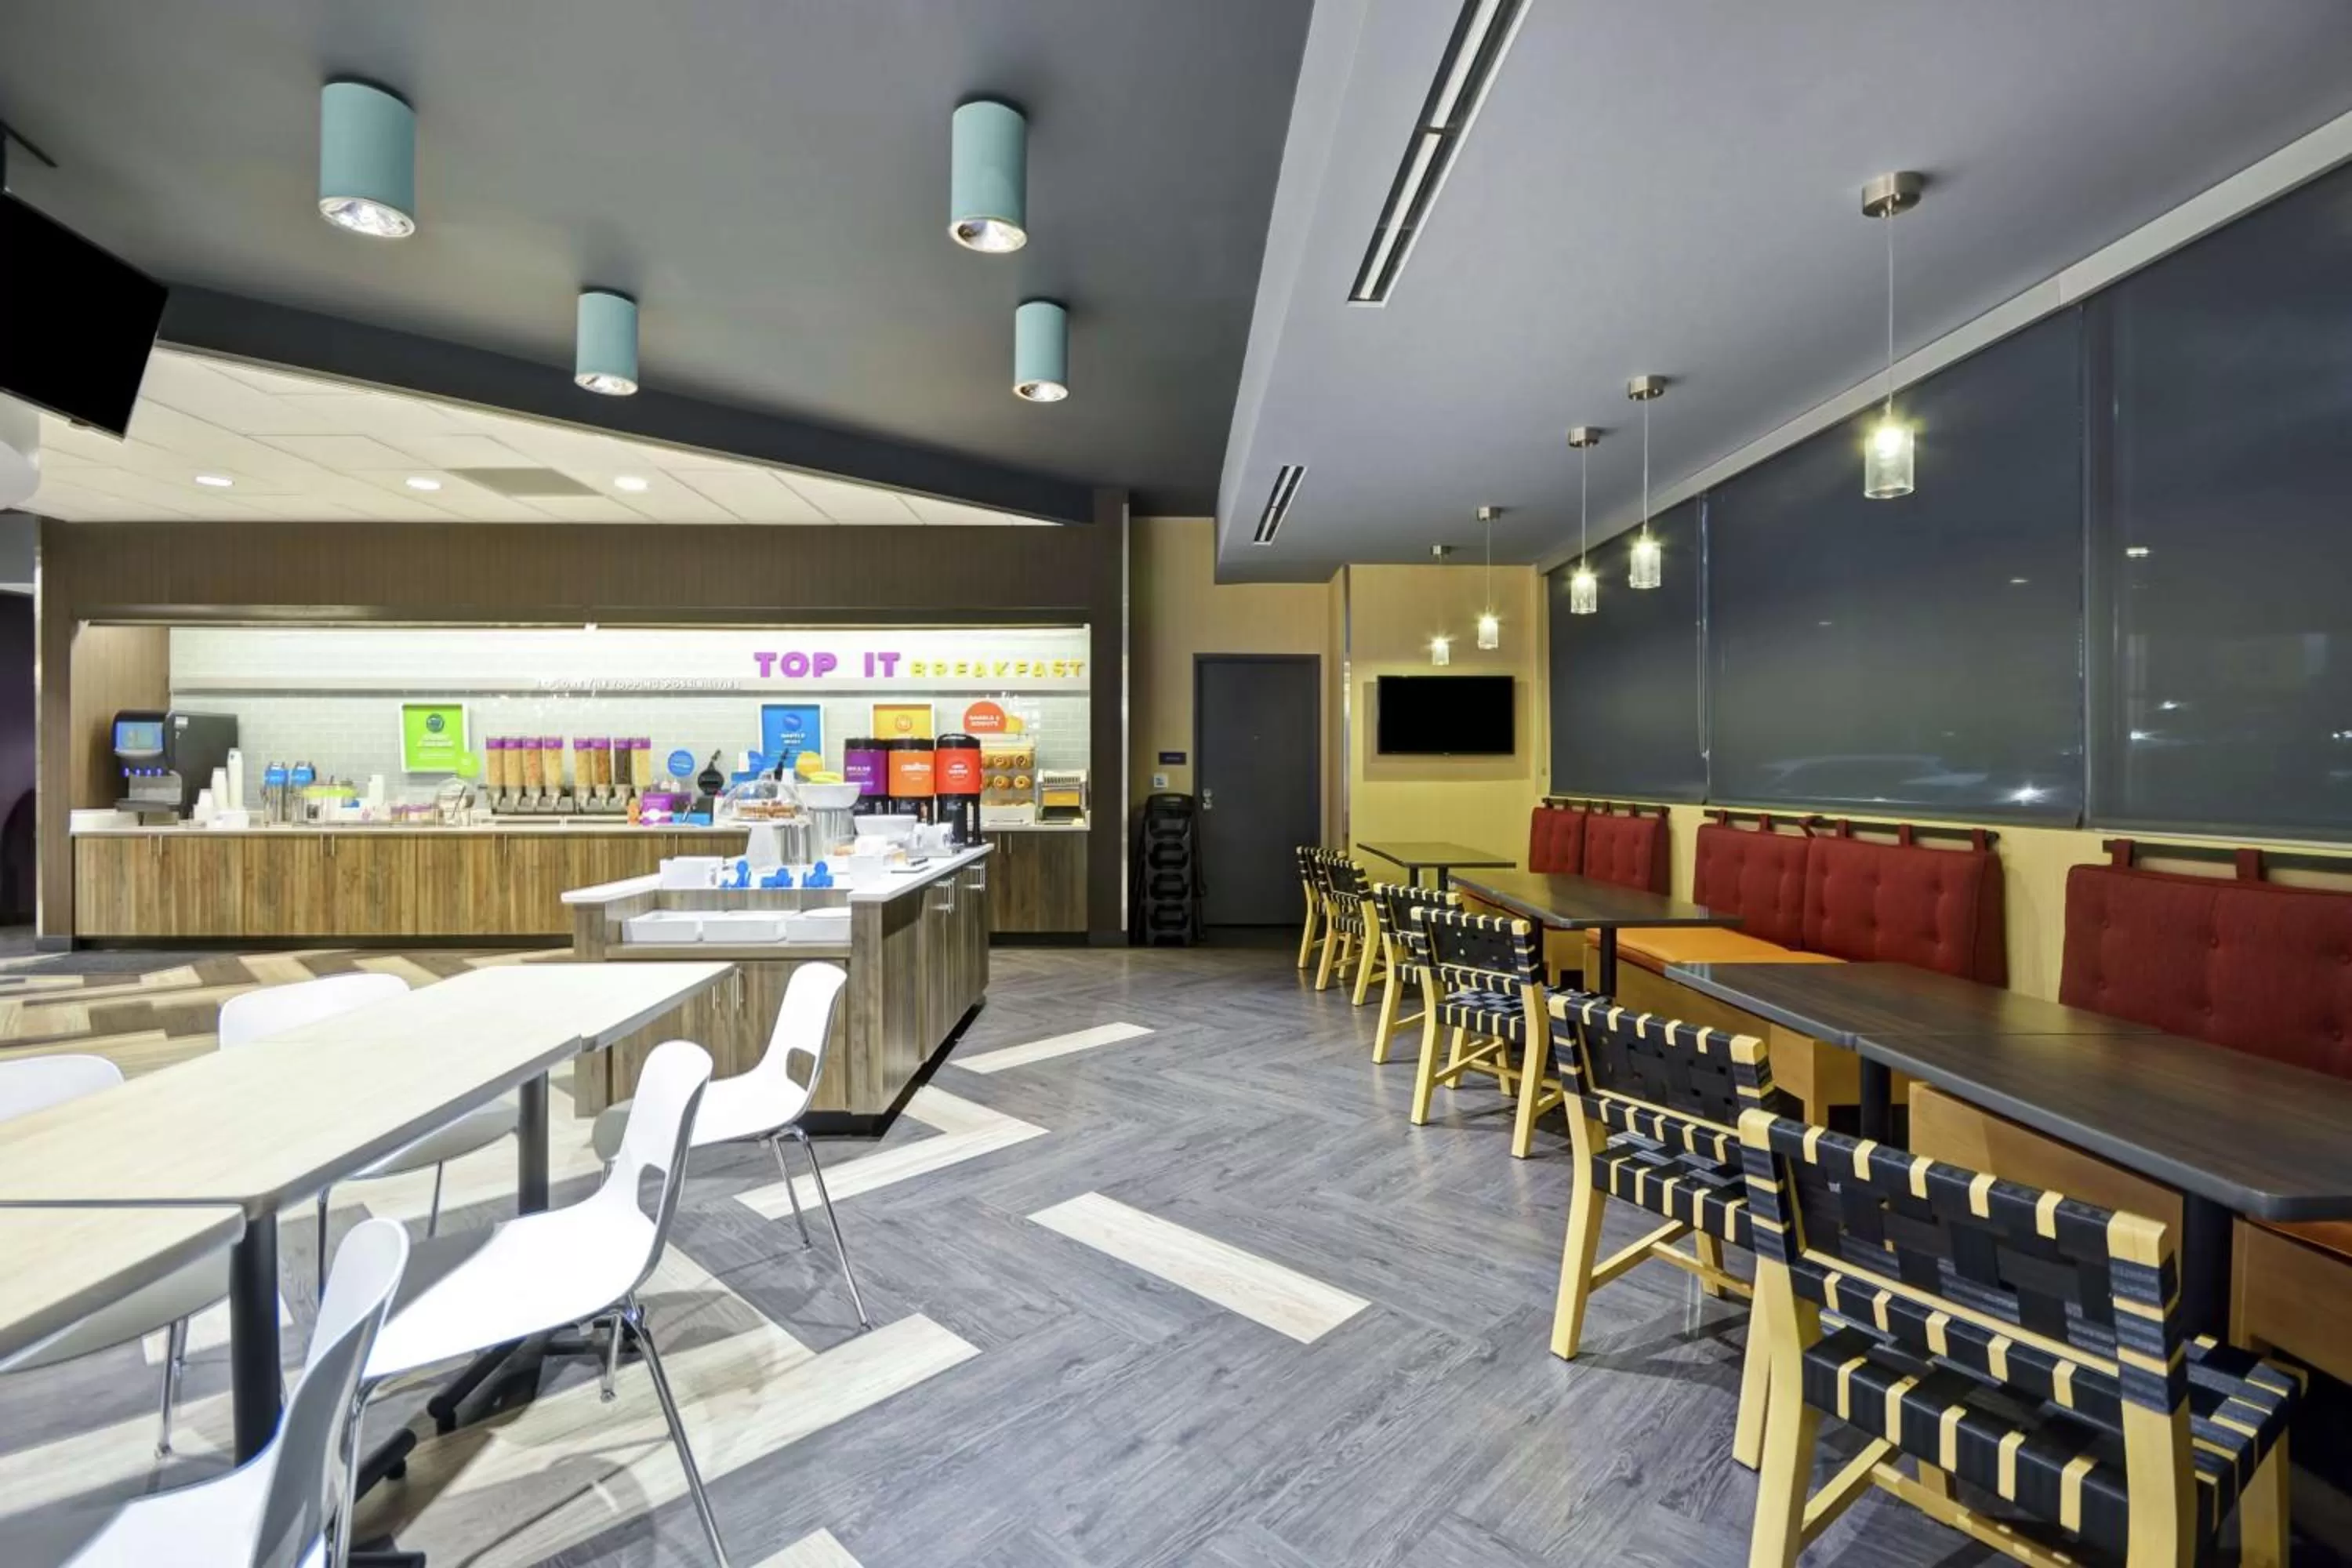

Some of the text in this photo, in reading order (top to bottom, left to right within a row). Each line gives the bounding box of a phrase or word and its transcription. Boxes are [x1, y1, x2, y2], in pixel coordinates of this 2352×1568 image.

[754, 652, 1083, 678] TOP IT BREAKFAST
